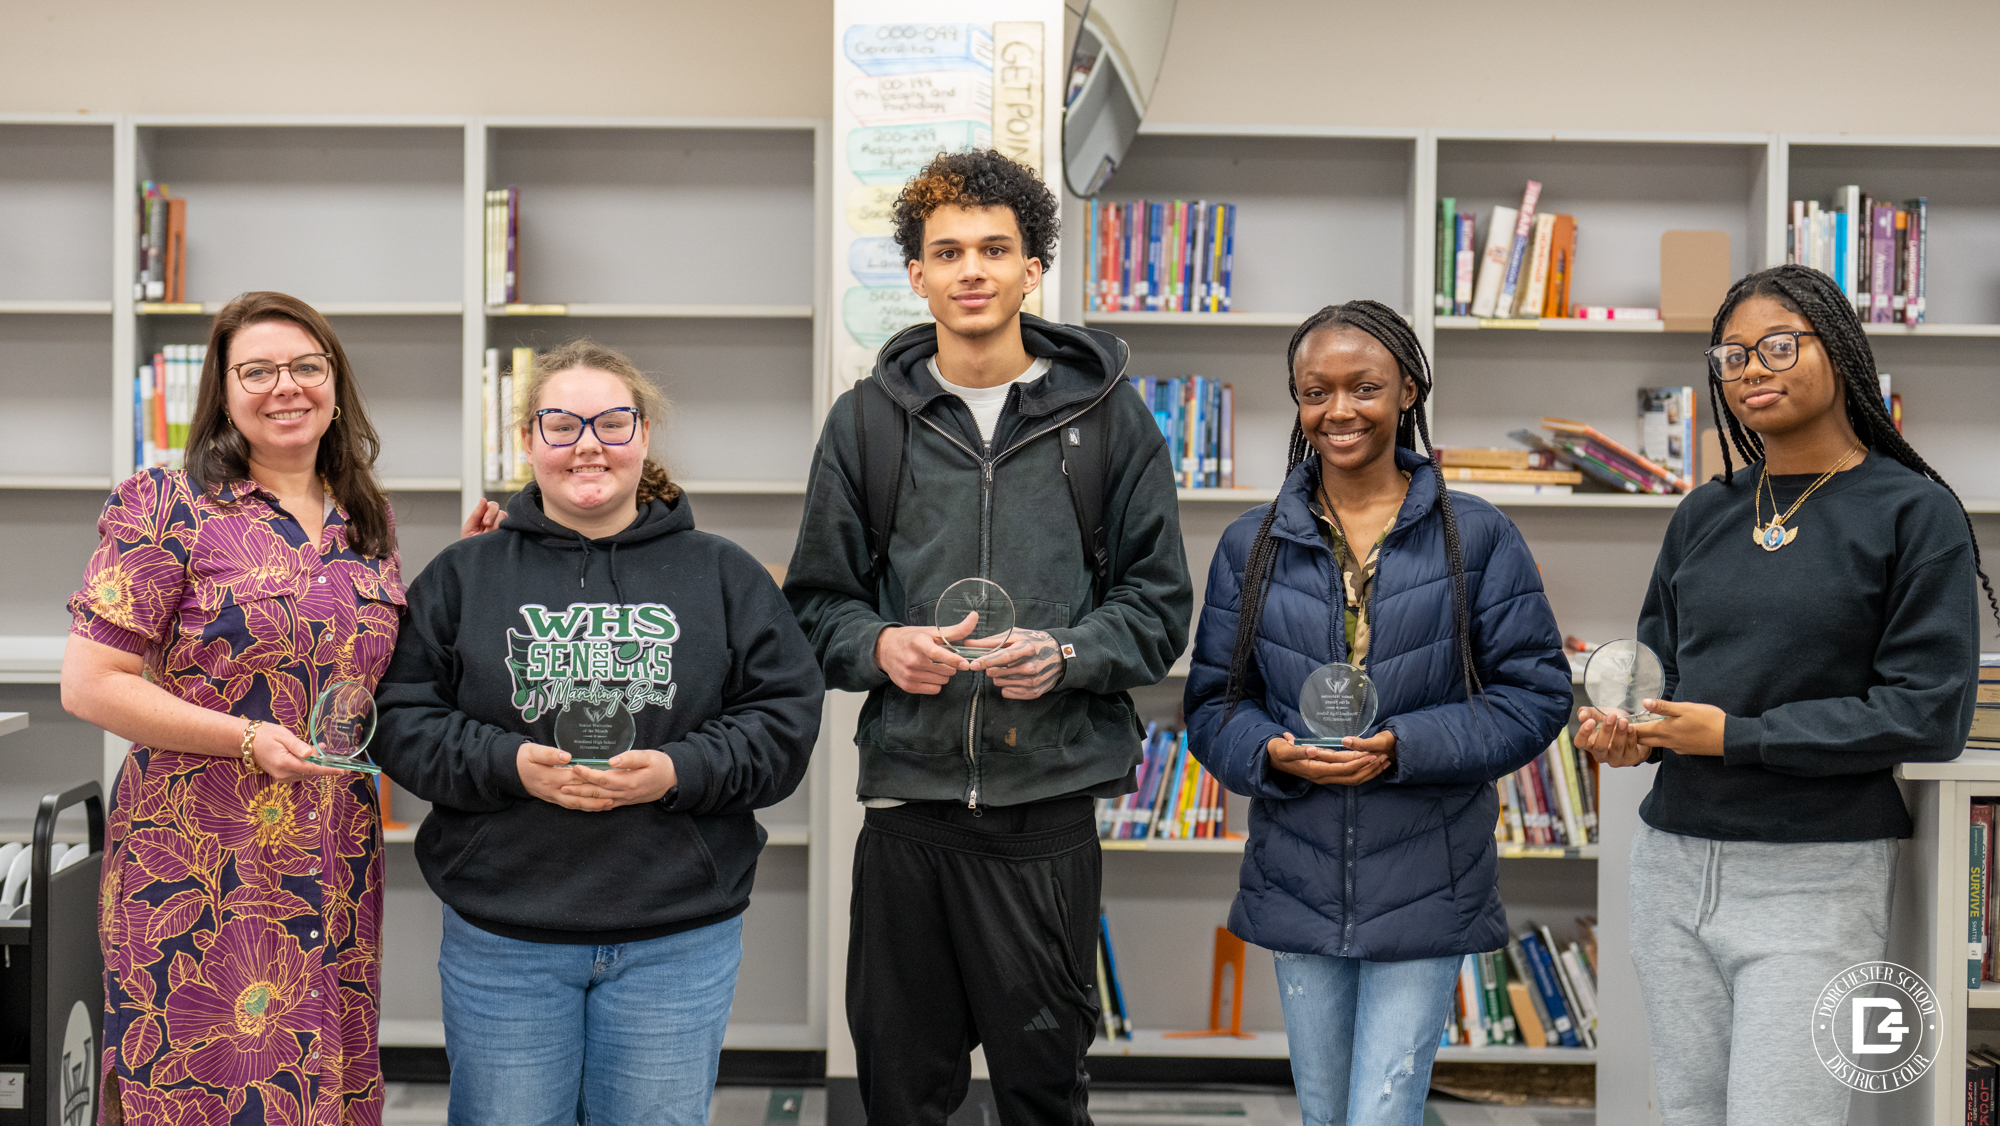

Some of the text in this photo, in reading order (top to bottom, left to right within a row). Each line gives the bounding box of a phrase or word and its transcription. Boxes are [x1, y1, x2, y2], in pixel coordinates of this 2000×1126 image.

[876, 25, 957, 41] 000-099
[1001, 41, 1035, 100] GET
[519, 602, 681, 643] WHS
[591, 642, 611, 679] 2026
[550, 678, 677, 718] Marching Band
[1969, 867, 1981, 918] SURVIVE
